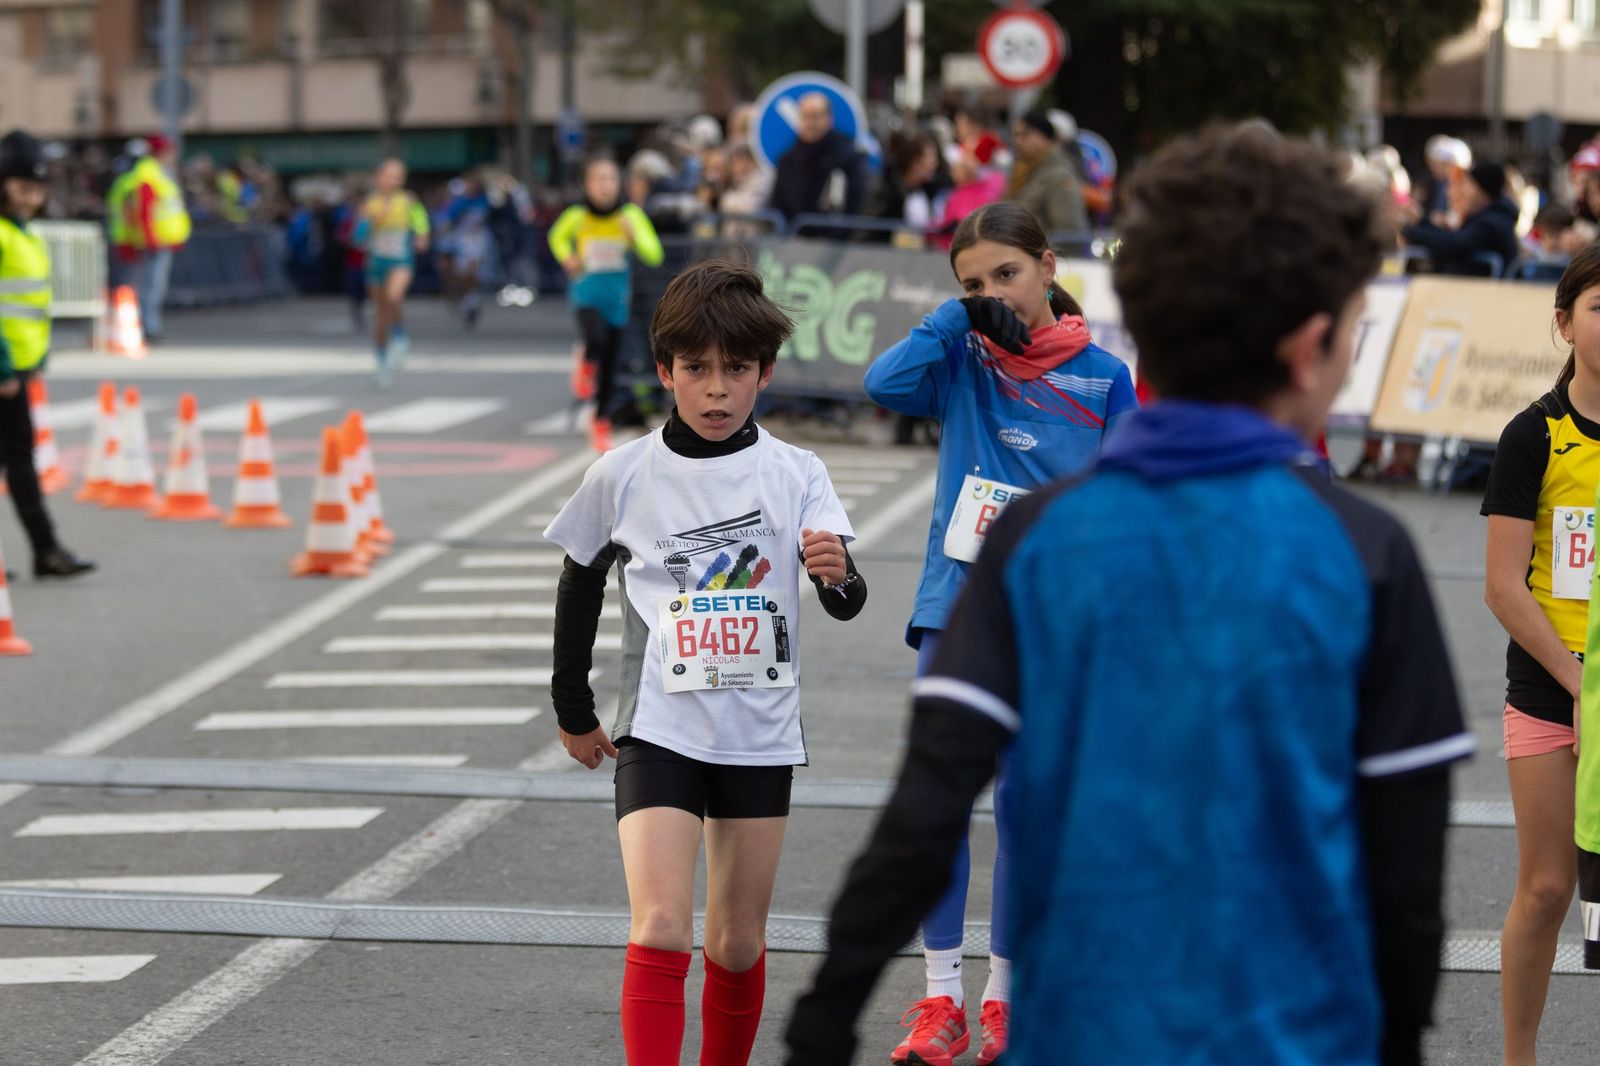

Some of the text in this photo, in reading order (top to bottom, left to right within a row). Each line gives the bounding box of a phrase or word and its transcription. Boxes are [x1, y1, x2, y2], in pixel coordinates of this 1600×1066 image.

[676, 617, 760, 658] 6462
[702, 656, 740, 665] NICOLAS
[720, 672, 754, 680] Ayuntamiento
